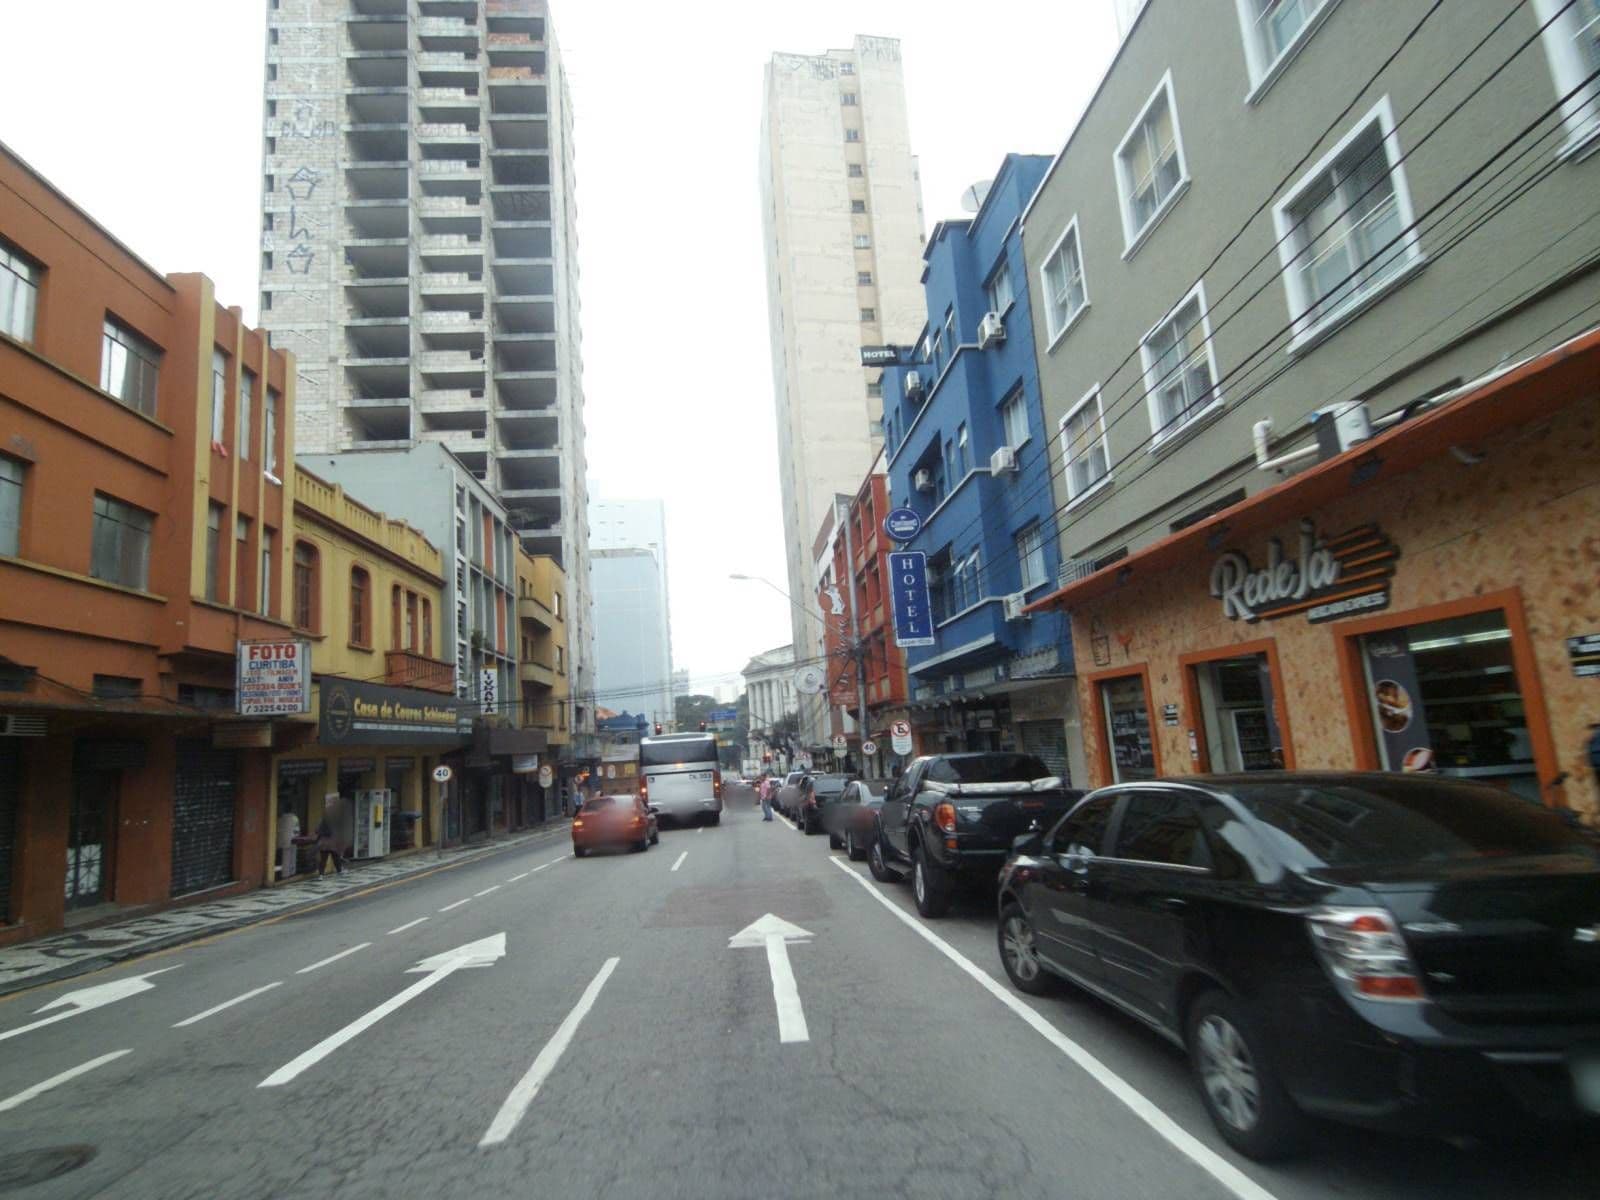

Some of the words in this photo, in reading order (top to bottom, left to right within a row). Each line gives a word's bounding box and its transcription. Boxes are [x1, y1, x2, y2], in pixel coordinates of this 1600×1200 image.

[863, 350, 896, 359] HOTEL
[902, 558, 920, 633] HOTEL
[250, 645, 296, 660] FOTO
[249, 660, 295, 670] CURITIBA
[354, 697, 378, 717] Casa
[381, 699, 393, 718] de
[864, 743, 875, 751] 40
[435, 769, 449, 778] 40
